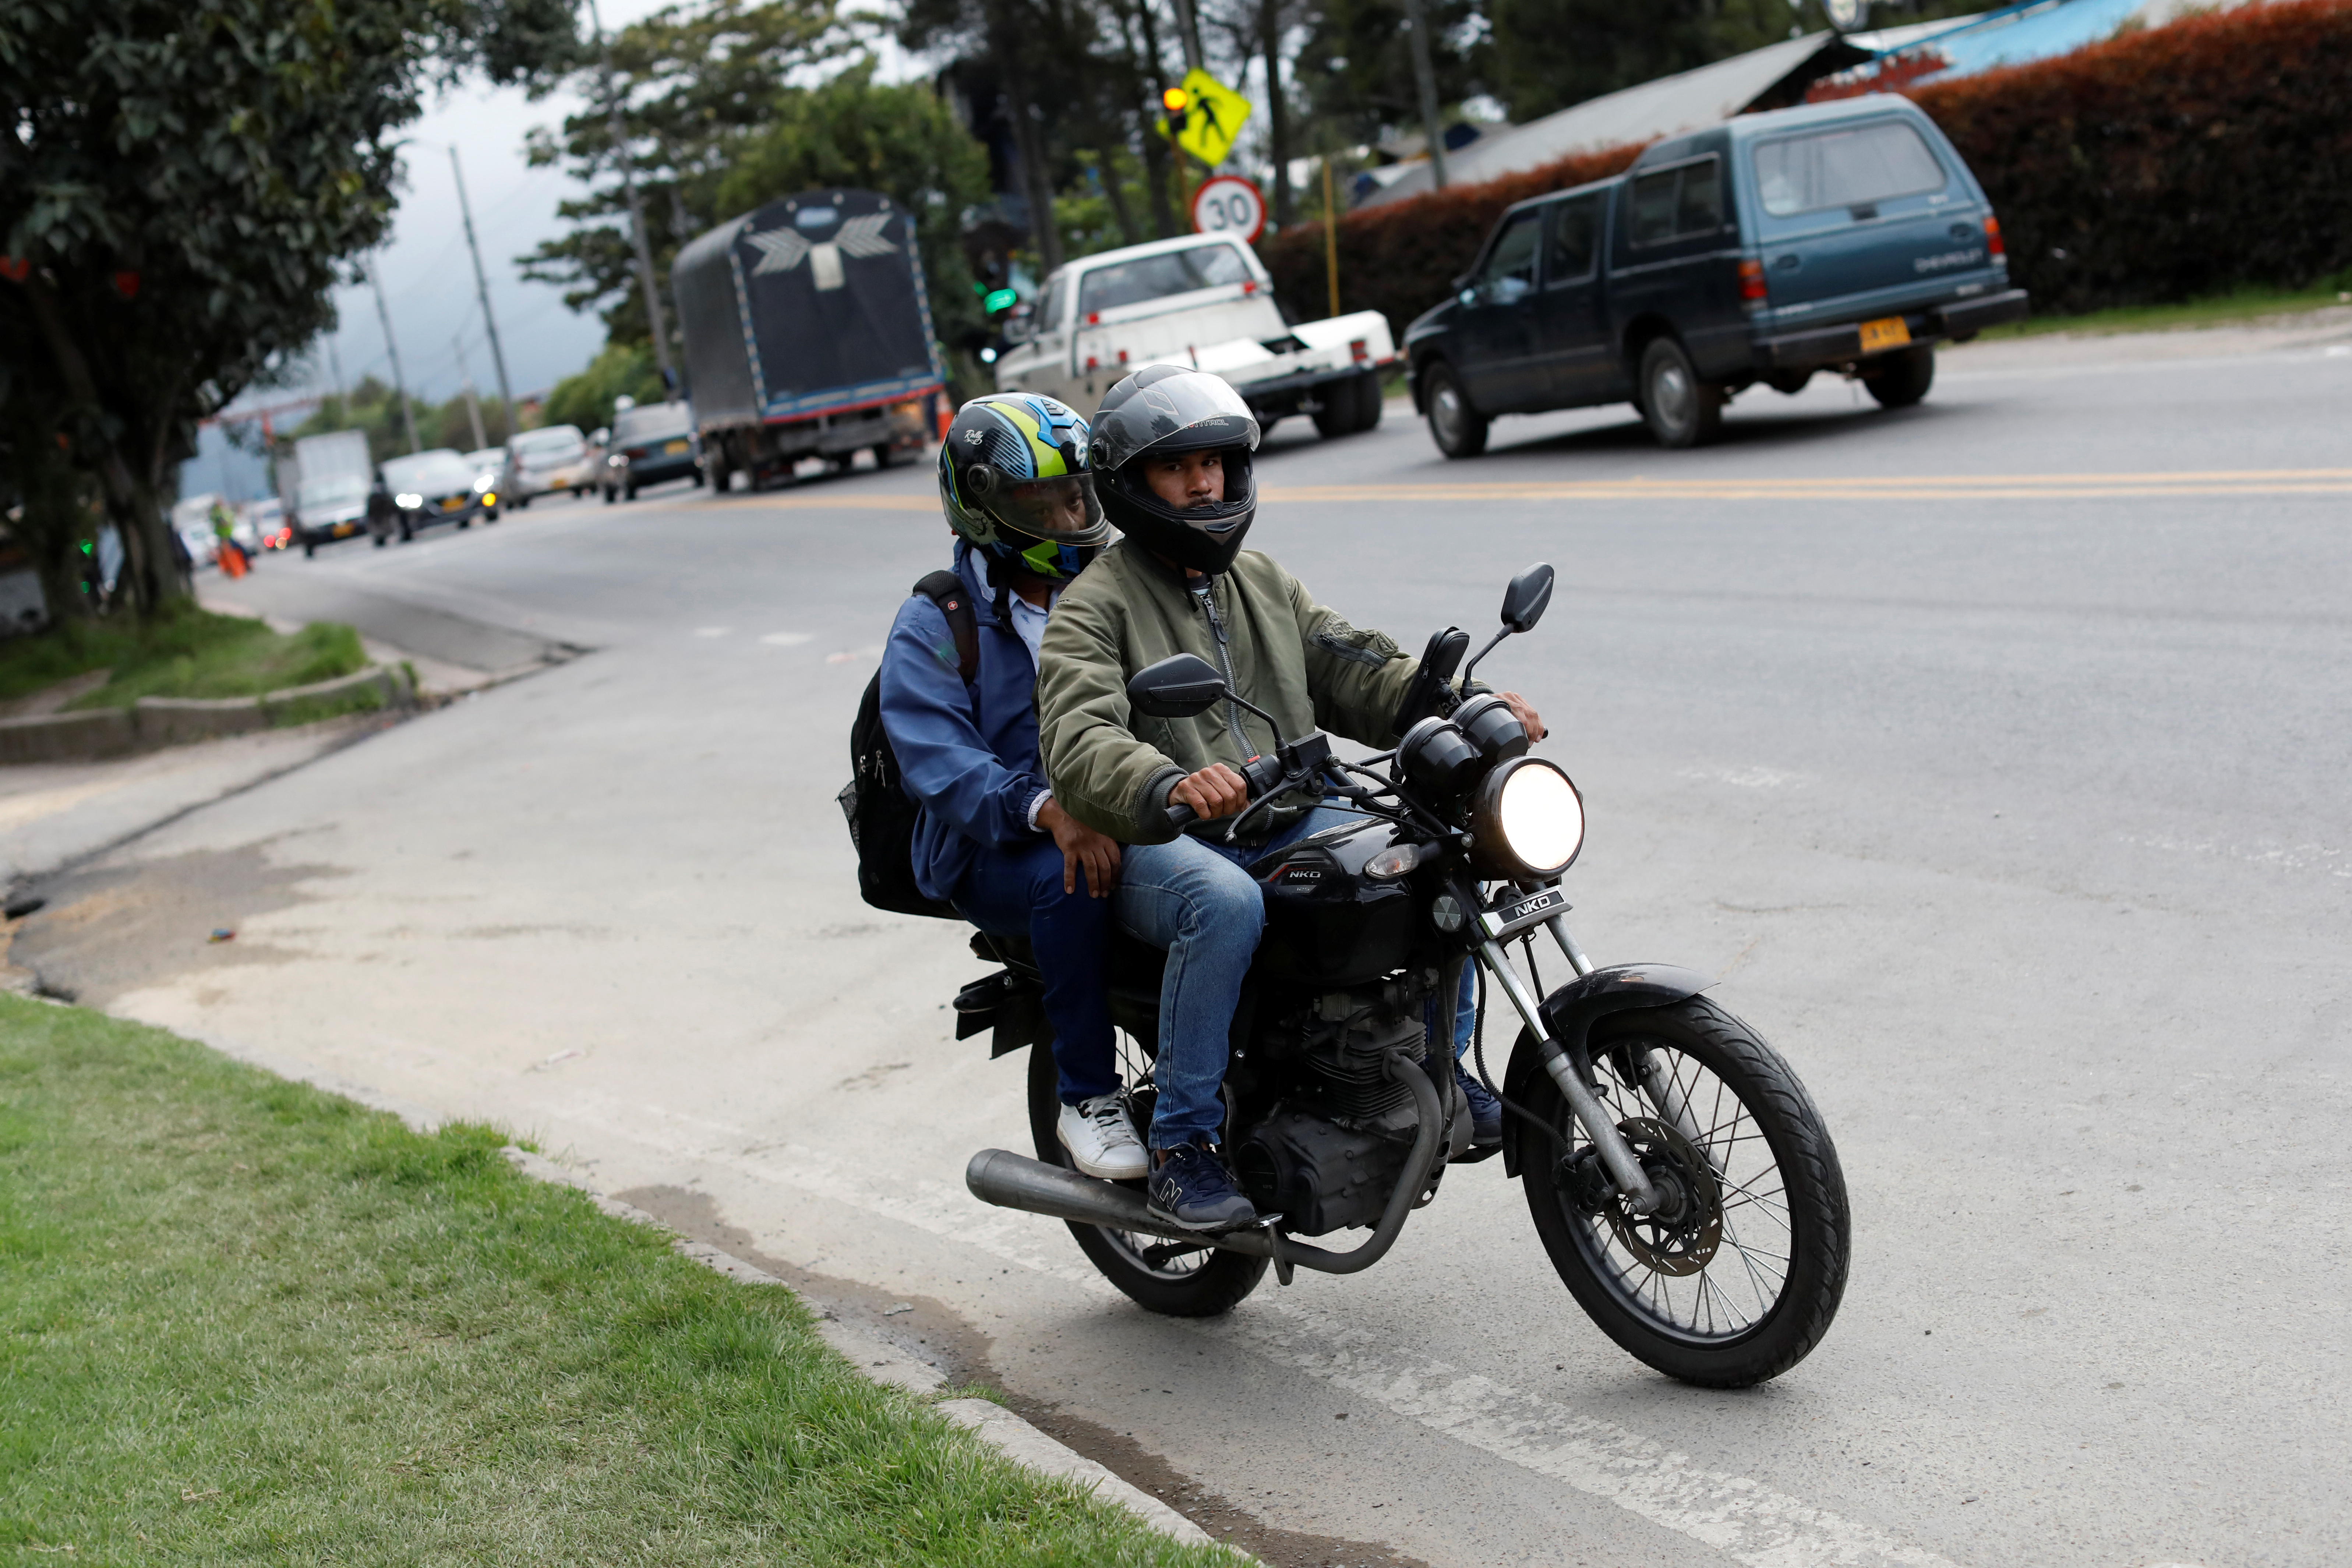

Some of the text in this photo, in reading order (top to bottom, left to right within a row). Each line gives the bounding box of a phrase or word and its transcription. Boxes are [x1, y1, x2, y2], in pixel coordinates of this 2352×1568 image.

[1208, 193, 1251, 230] 30
[964, 429, 983, 445] Rally
[1514, 896, 1550, 917] NKD
[1159, 1177, 1183, 1211] N
